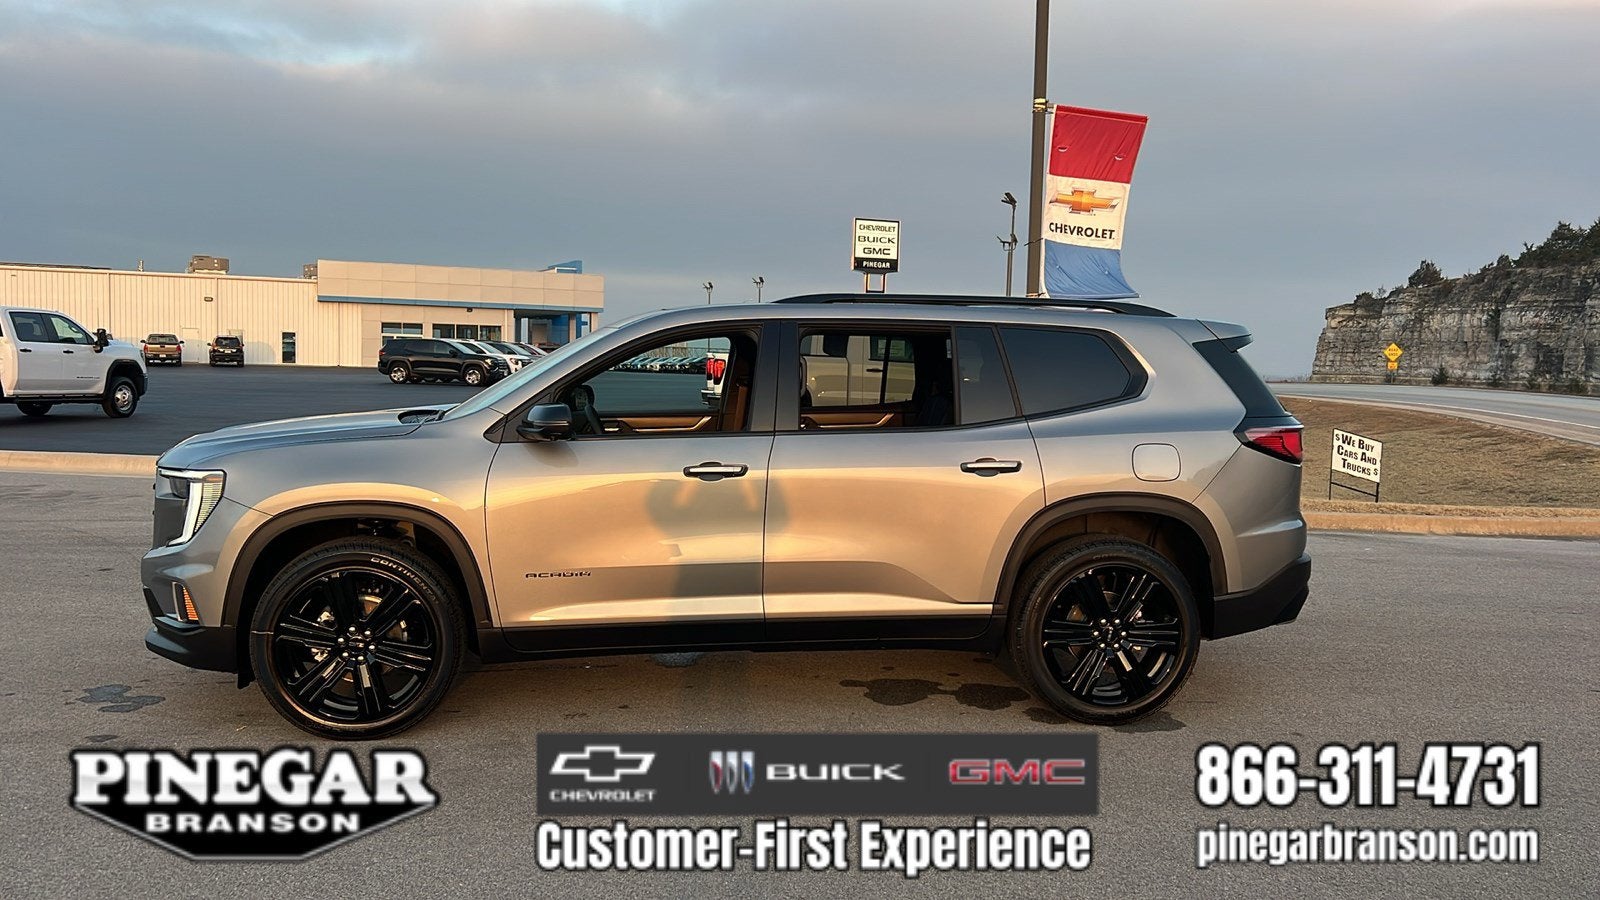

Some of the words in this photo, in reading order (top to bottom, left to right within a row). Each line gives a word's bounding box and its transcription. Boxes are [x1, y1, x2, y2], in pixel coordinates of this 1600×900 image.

[859, 224, 896, 232] CHEVROLET
[1049, 222, 1115, 240] CHEVROLET
[858, 235, 895, 244] BUICK
[863, 247, 890, 255] GMC
[1358, 439, 1374, 452] BUY
[1337, 445, 1359, 460] CARS
[1360, 452, 1377, 465] AND
[1341, 458, 1371, 475] TRUCKS
